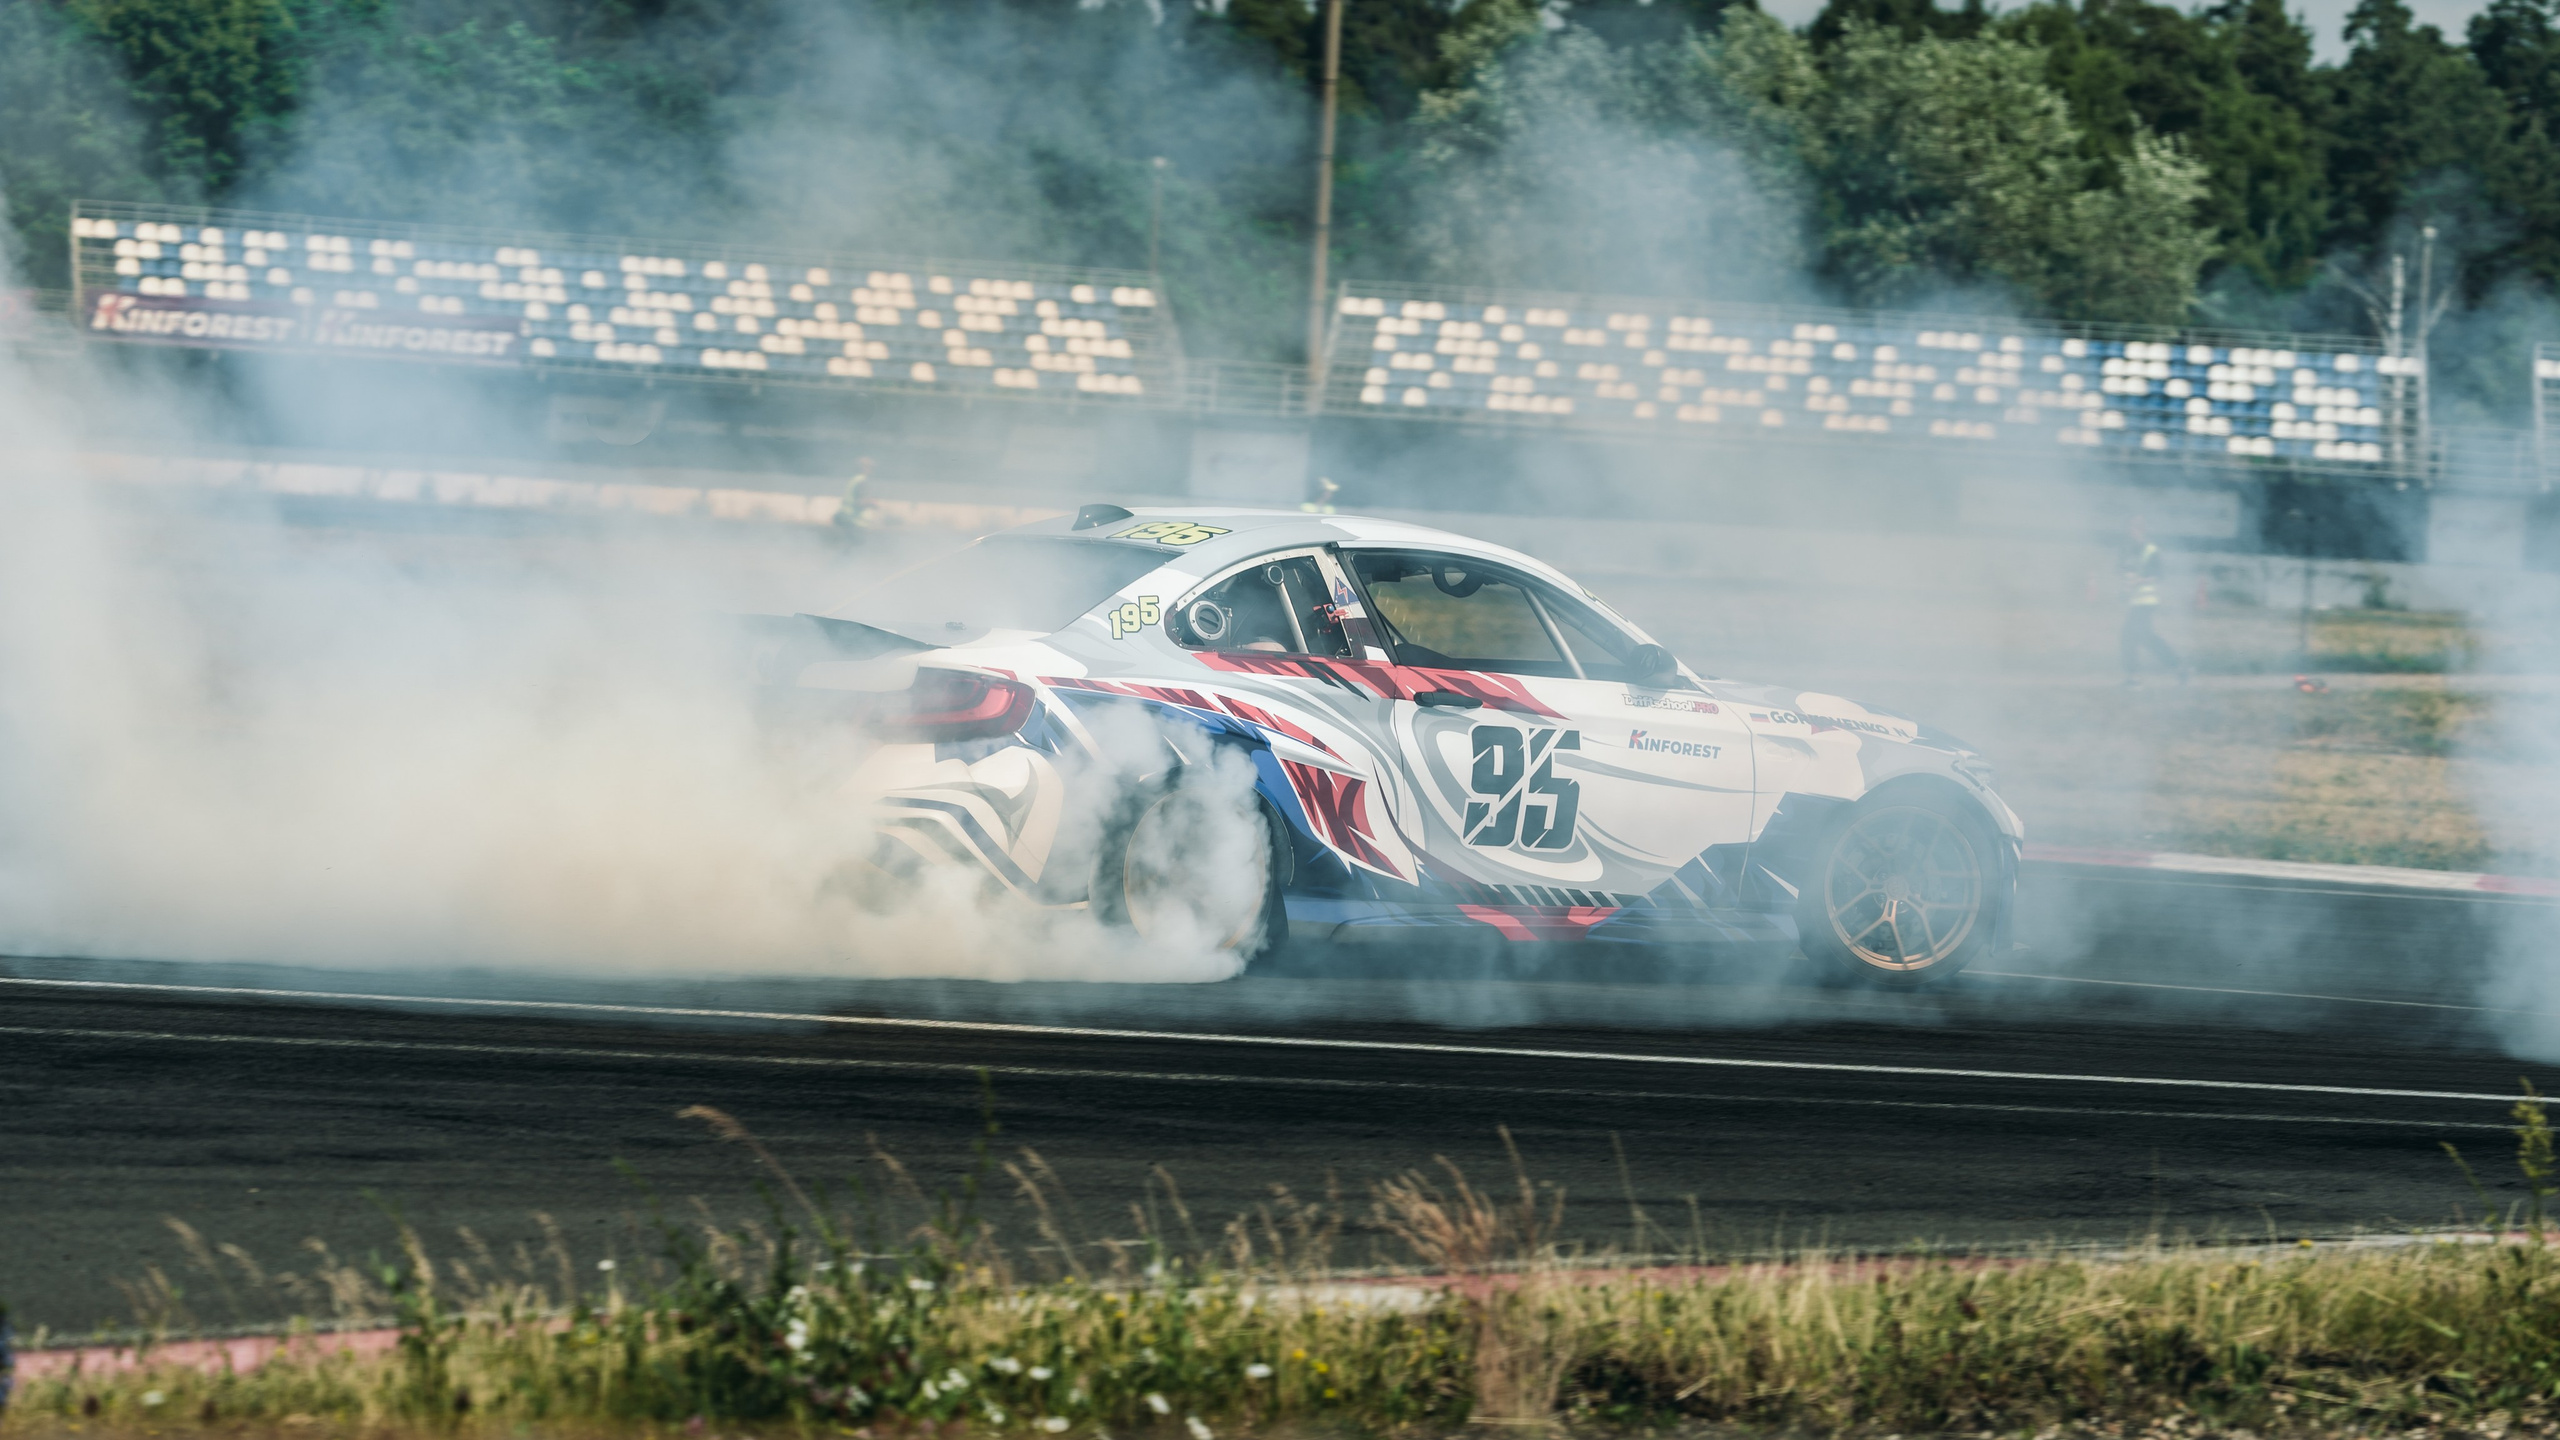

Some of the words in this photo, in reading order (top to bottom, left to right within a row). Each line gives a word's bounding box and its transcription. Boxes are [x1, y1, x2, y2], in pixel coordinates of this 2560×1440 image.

[92, 292, 296, 341] KINFOREST
[313, 308, 516, 355] KINFOREST
[1106, 521, 1233, 546] 195
[1108, 595, 1160, 640] 195
[1628, 729, 1722, 759] KINFOREST
[1463, 724, 1581, 849] 95
